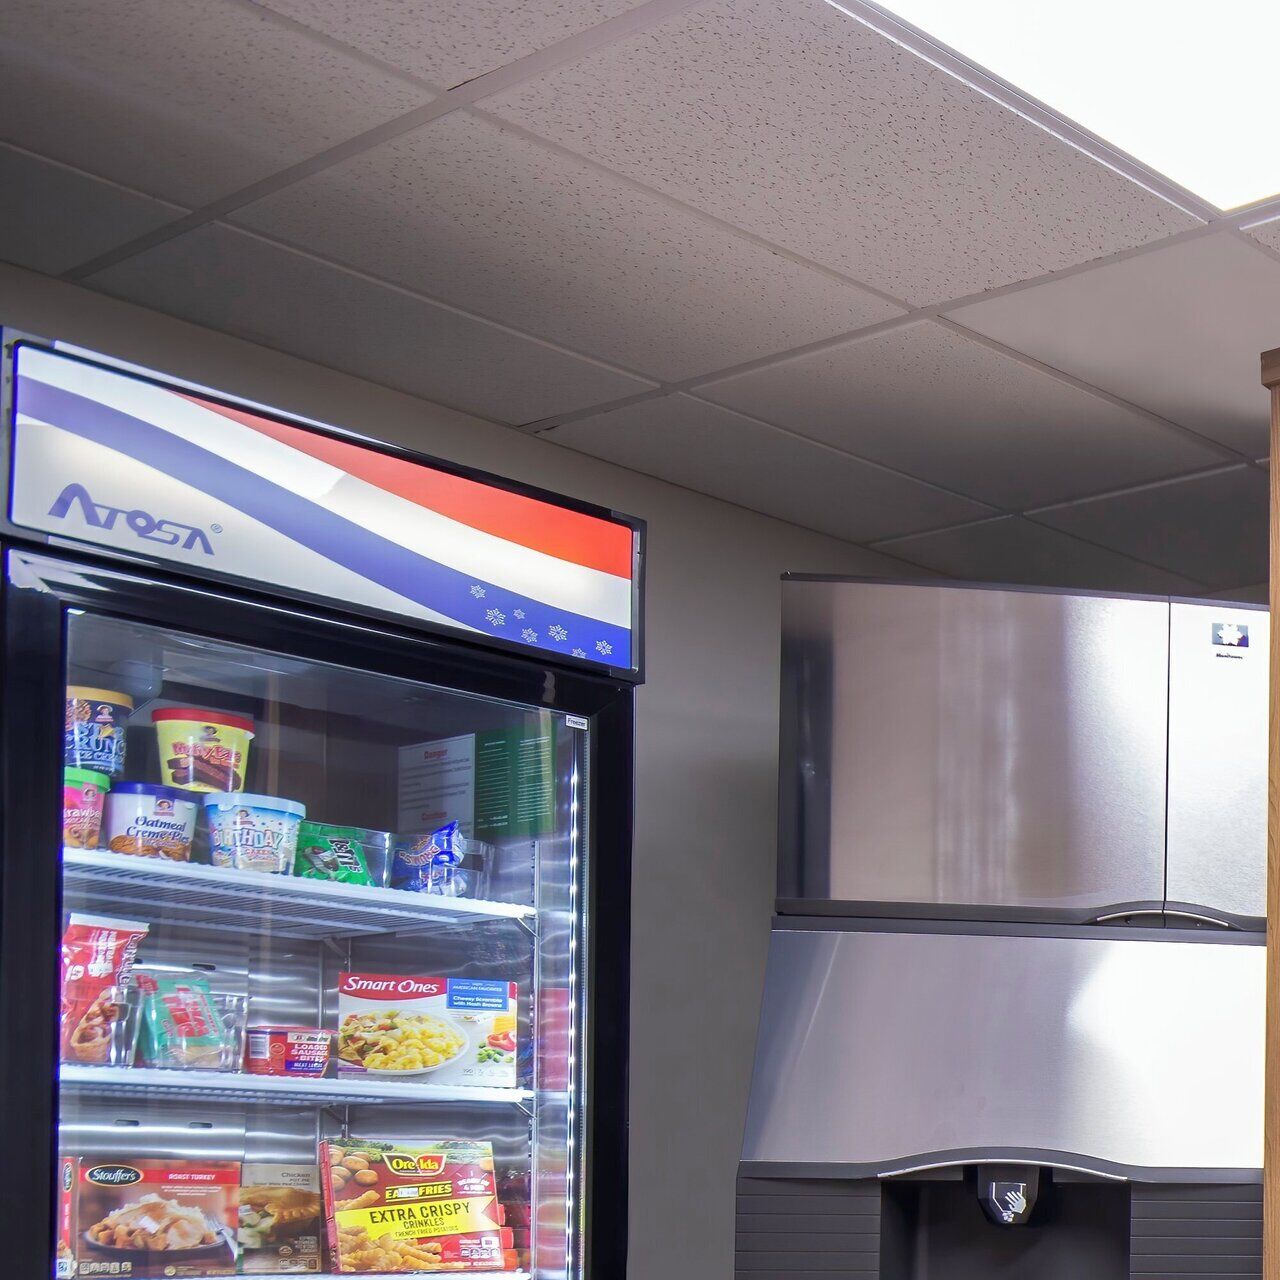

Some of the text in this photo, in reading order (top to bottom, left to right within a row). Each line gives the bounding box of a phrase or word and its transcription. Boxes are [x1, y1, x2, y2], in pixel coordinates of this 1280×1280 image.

[567, 717, 587, 728] Freezer
[135, 816, 187, 831] Oatmeal
[127, 826, 167, 839] Creme
[213, 828, 283, 850] BIRTHDAY
[344, 976, 439, 994] Smart Ones
[92, 1169, 137, 1182] Stouffer's
[418, 1184, 452, 1197] FRIES
[369, 1201, 471, 1224] EXTRA CRISPY
[403, 1217, 445, 1230] CRINKLES
